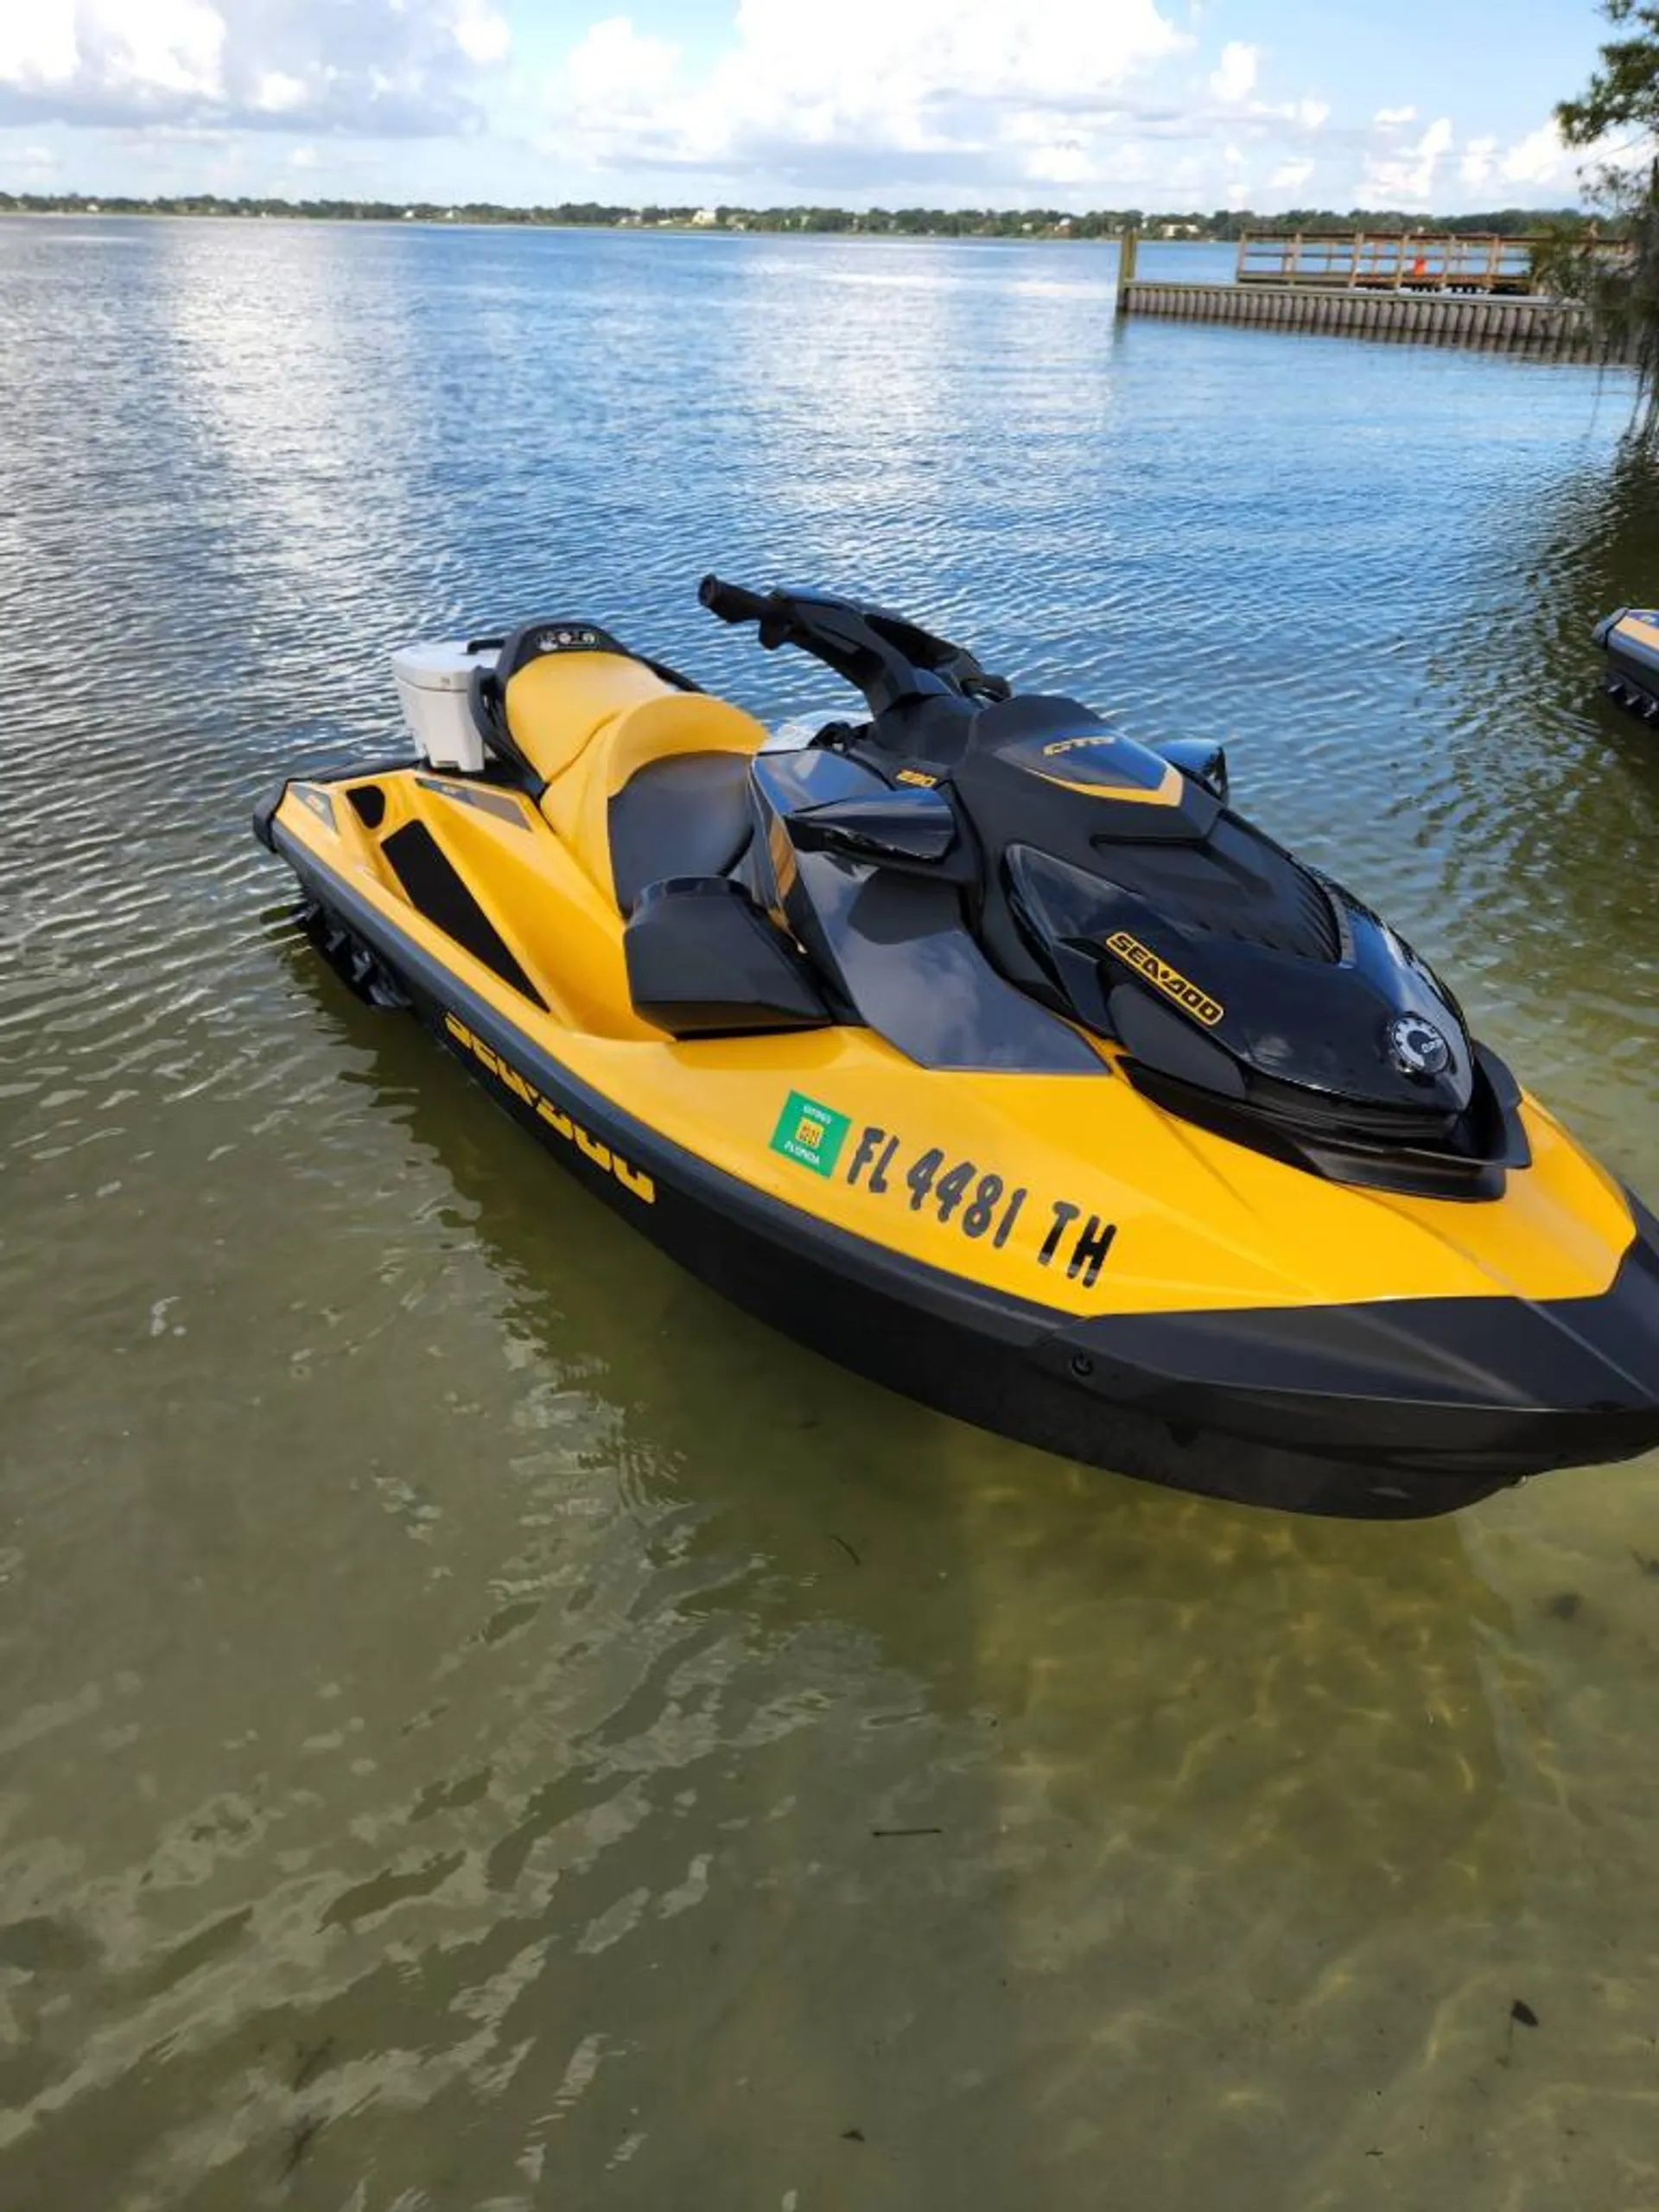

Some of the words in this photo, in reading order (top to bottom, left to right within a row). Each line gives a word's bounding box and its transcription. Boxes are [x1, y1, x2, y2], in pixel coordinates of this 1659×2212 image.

[847, 1127, 899, 1193] FL
[907, 1147, 1027, 1249] 4481
[1037, 1201, 1117, 1288] TH
